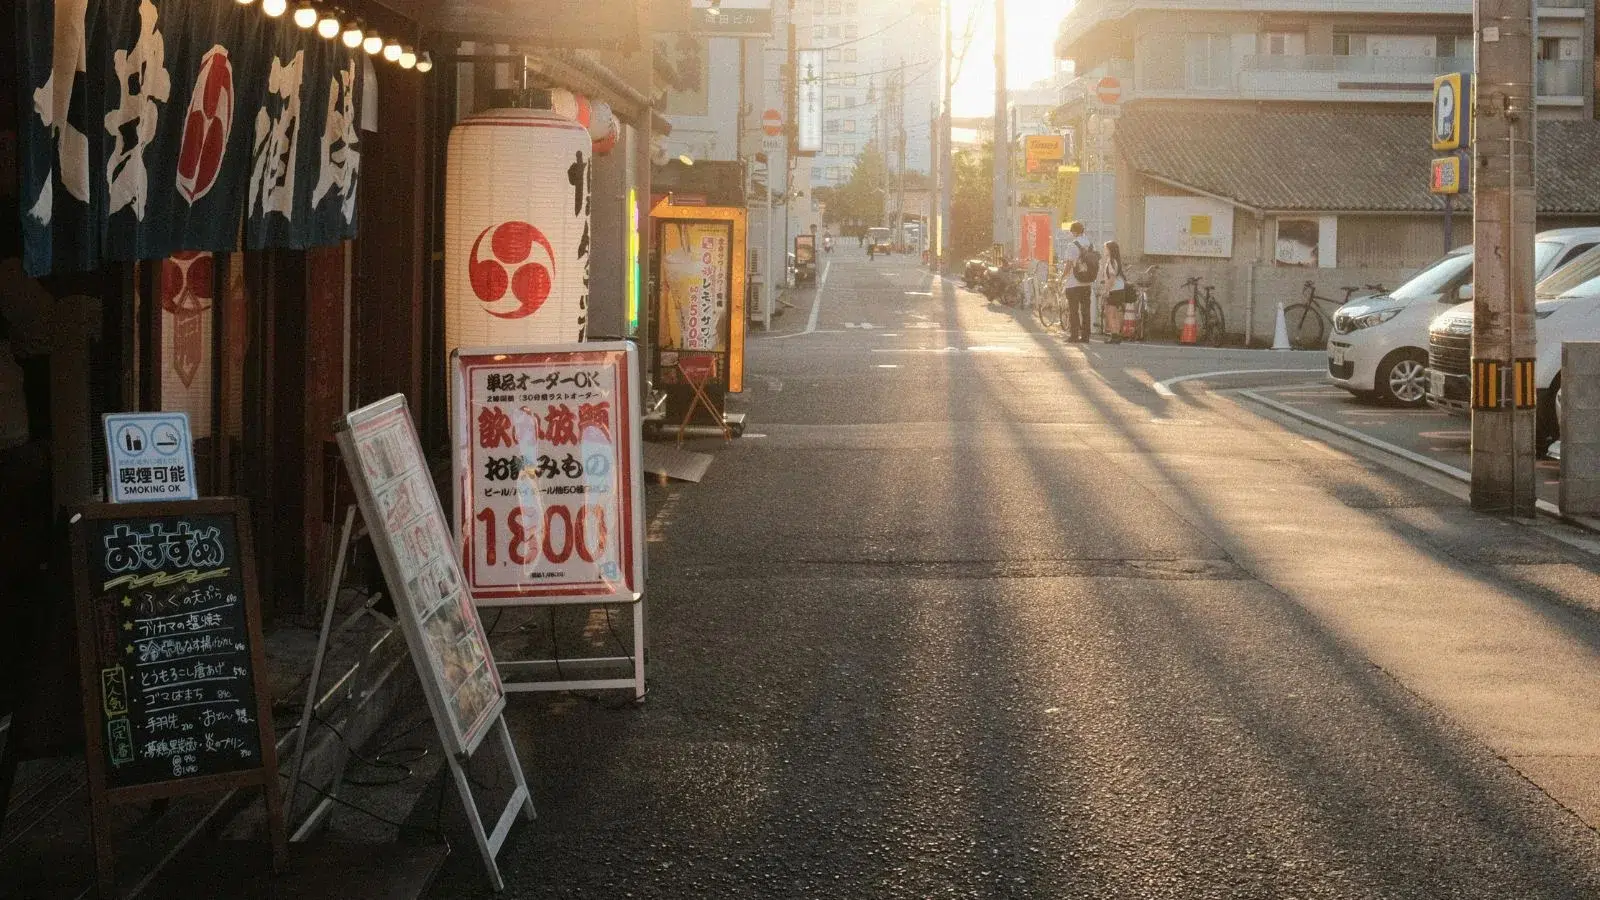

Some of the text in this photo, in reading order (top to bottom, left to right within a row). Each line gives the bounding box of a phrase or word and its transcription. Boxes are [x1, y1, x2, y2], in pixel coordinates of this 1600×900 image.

[478, 402, 612, 449] 飲放題
[119, 465, 186, 484] 喫煙可能
[124, 484, 181, 495] SMOKING OK
[104, 521, 225, 573] おすすめ
[476, 504, 608, 567] 1,800
[141, 660, 247, 687] とうもろこし唐あげ 590
[144, 688, 204, 706] ゴマはまち
